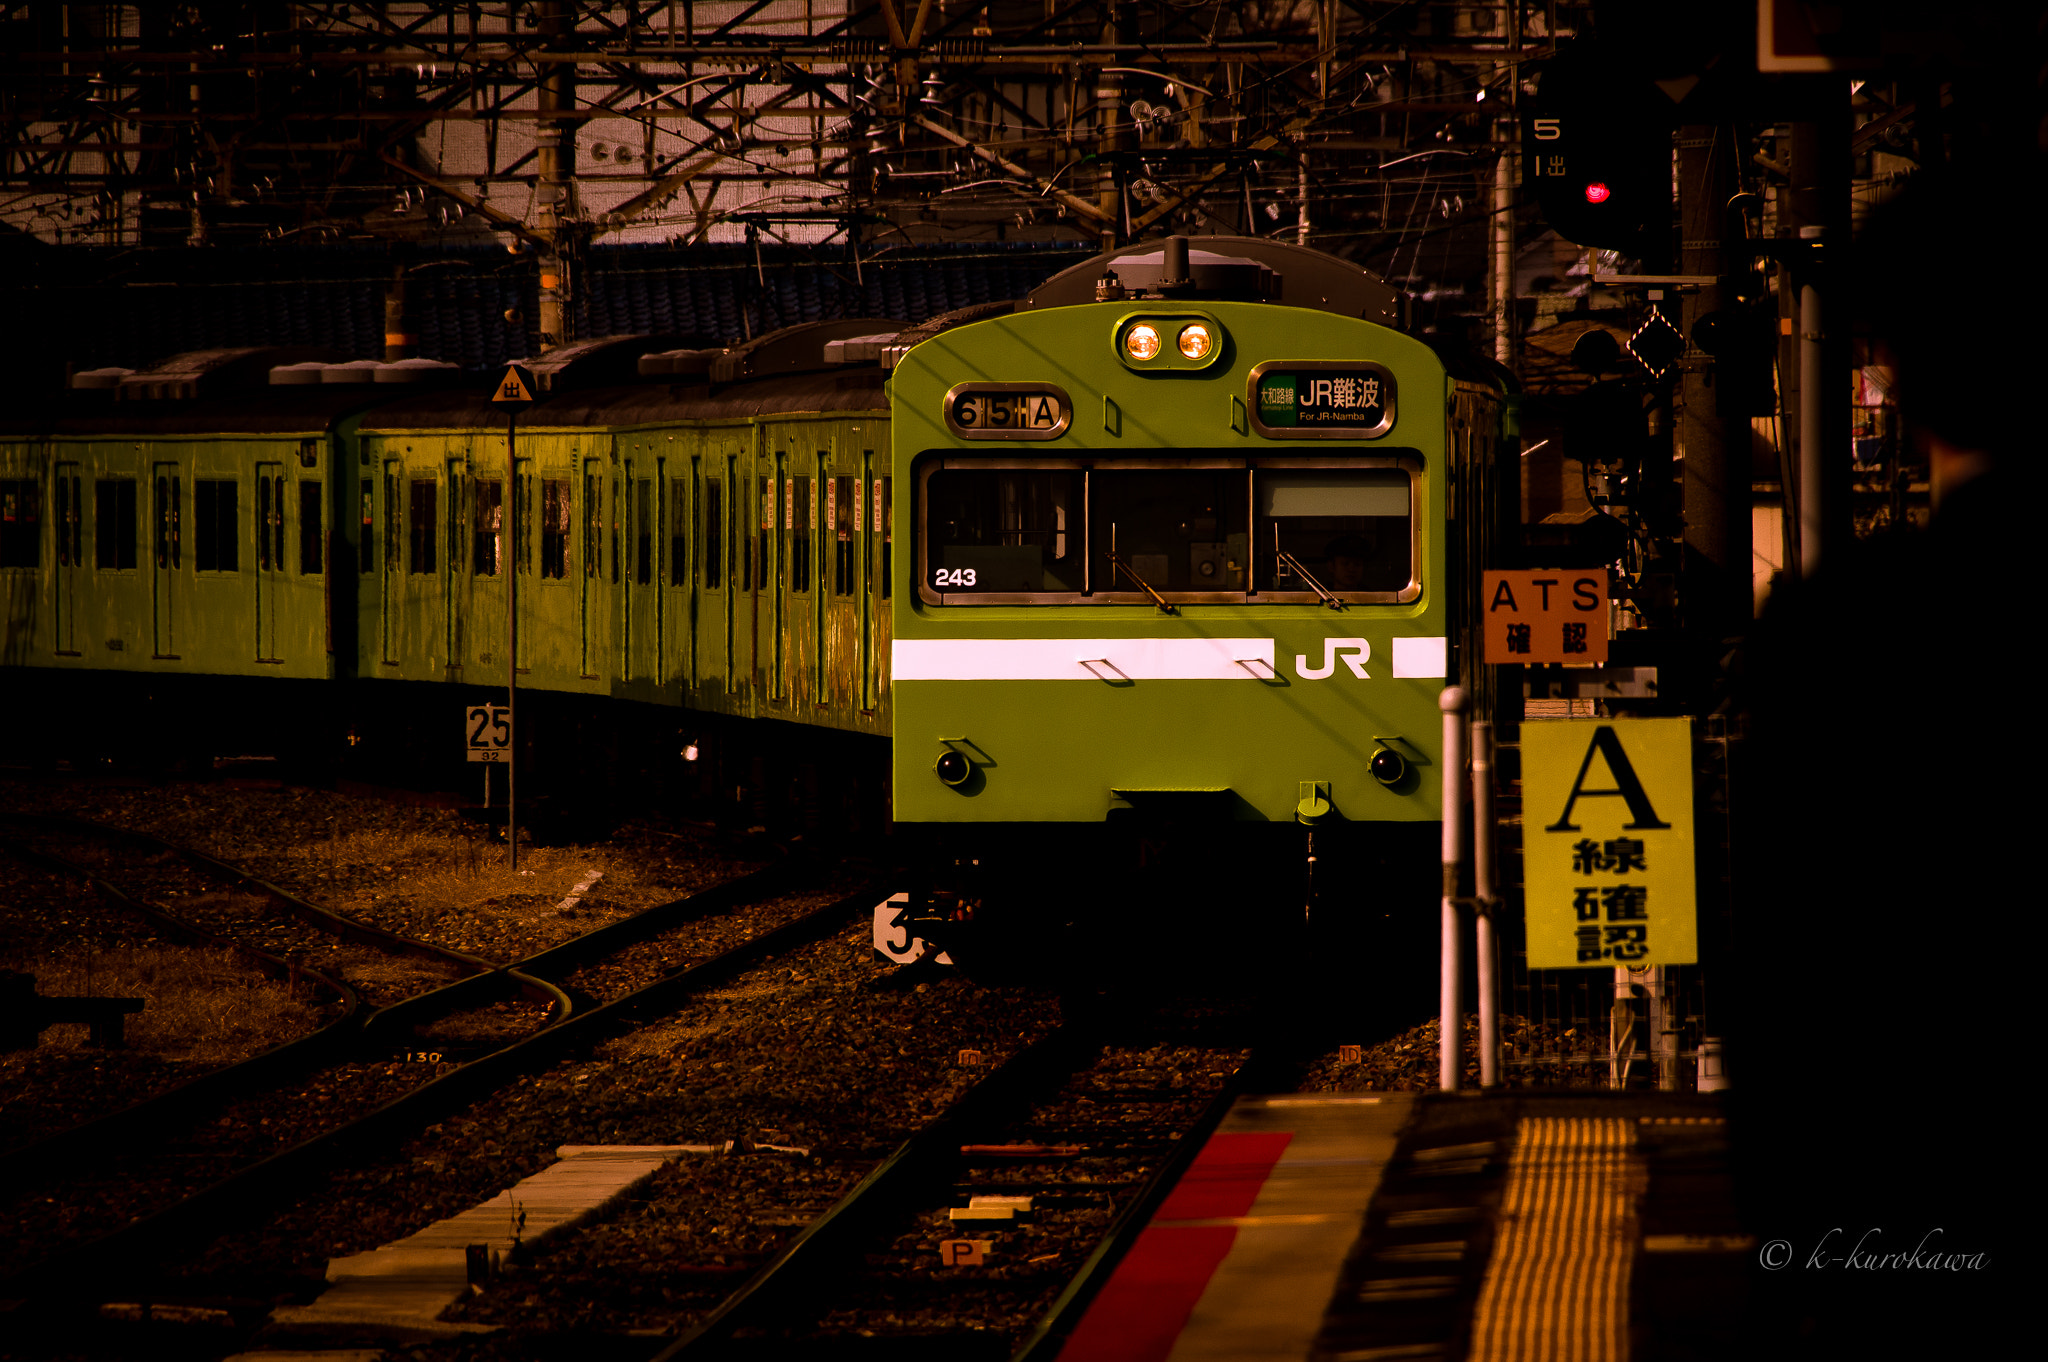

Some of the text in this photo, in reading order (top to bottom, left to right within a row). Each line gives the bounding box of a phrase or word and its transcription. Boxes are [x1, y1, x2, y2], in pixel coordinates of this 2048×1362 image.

[1534, 119, 1560, 140] 5
[505, 383, 519, 398] 出
[1261, 387, 1295, 405] 大和路線
[1300, 378, 1380, 408] JR難波
[1034, 397, 1054, 425] A
[1300, 412, 1365, 421] For JR-Namba
[935, 568, 977, 587] 243
[1507, 623, 1587, 655] 確認
[1295, 637, 1371, 681] JR
[470, 709, 510, 747] 25
[482, 752, 499, 761] 92
[952, 1243, 973, 1266] P
